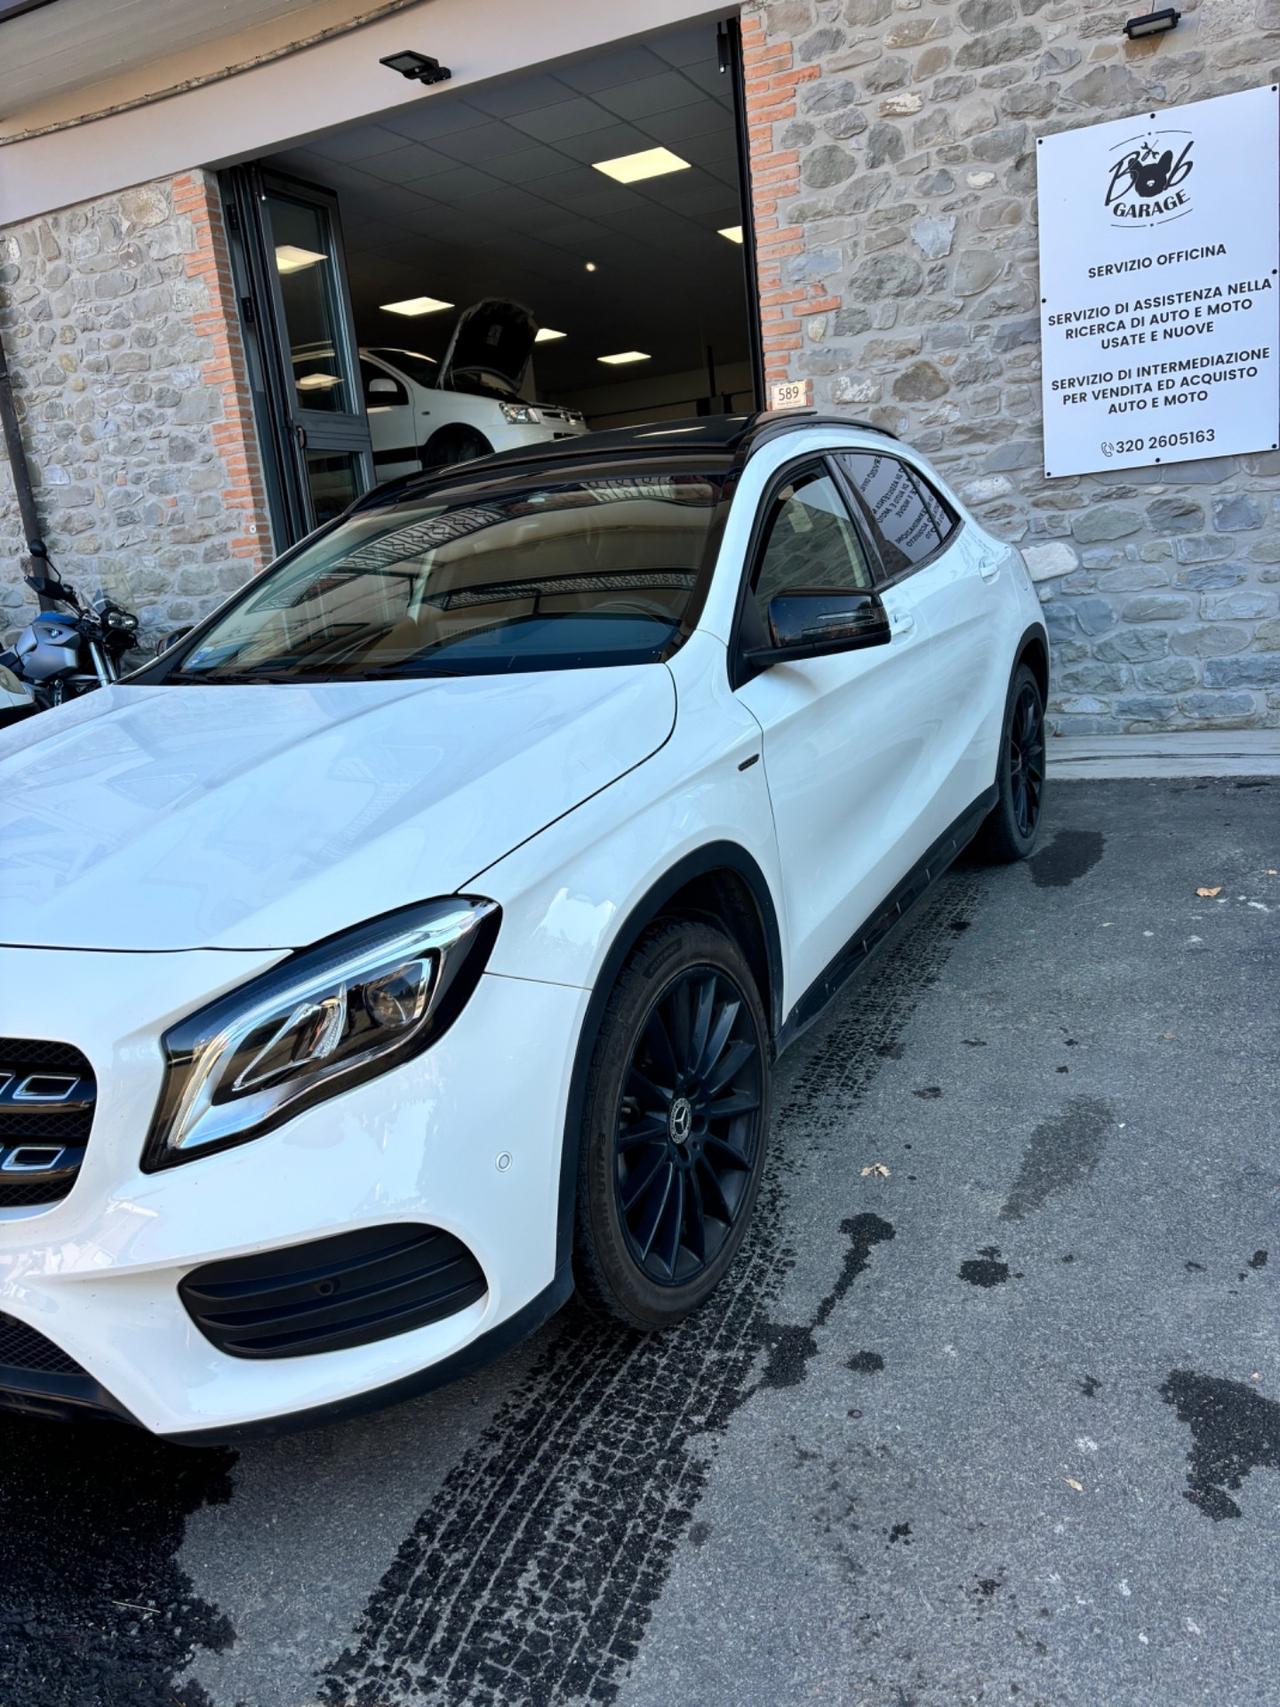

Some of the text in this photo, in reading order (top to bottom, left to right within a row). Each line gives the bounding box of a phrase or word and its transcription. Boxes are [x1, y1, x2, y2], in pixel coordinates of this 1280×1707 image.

[1113, 189, 1191, 218] GARAGE
[1088, 244, 1227, 278] SERVIZIO OFFICINA
[1048, 278, 1273, 326] SERVIZIO DI ASSISTENZA NELLA
[1065, 298, 1253, 340] RICERCA DI AUTO E MOTO
[1101, 321, 1215, 350] USATE E NUOVE
[1051, 347, 1271, 391] SERVIZIO DI INTERMEDIAZIONE
[778, 385, 800, 401] 589
[1063, 366, 1259, 406] PER VENDITA ED ACQUISTO
[1108, 390, 1209, 415] AUTO E MOTO
[1115, 428, 1216, 454] 320 2605163
